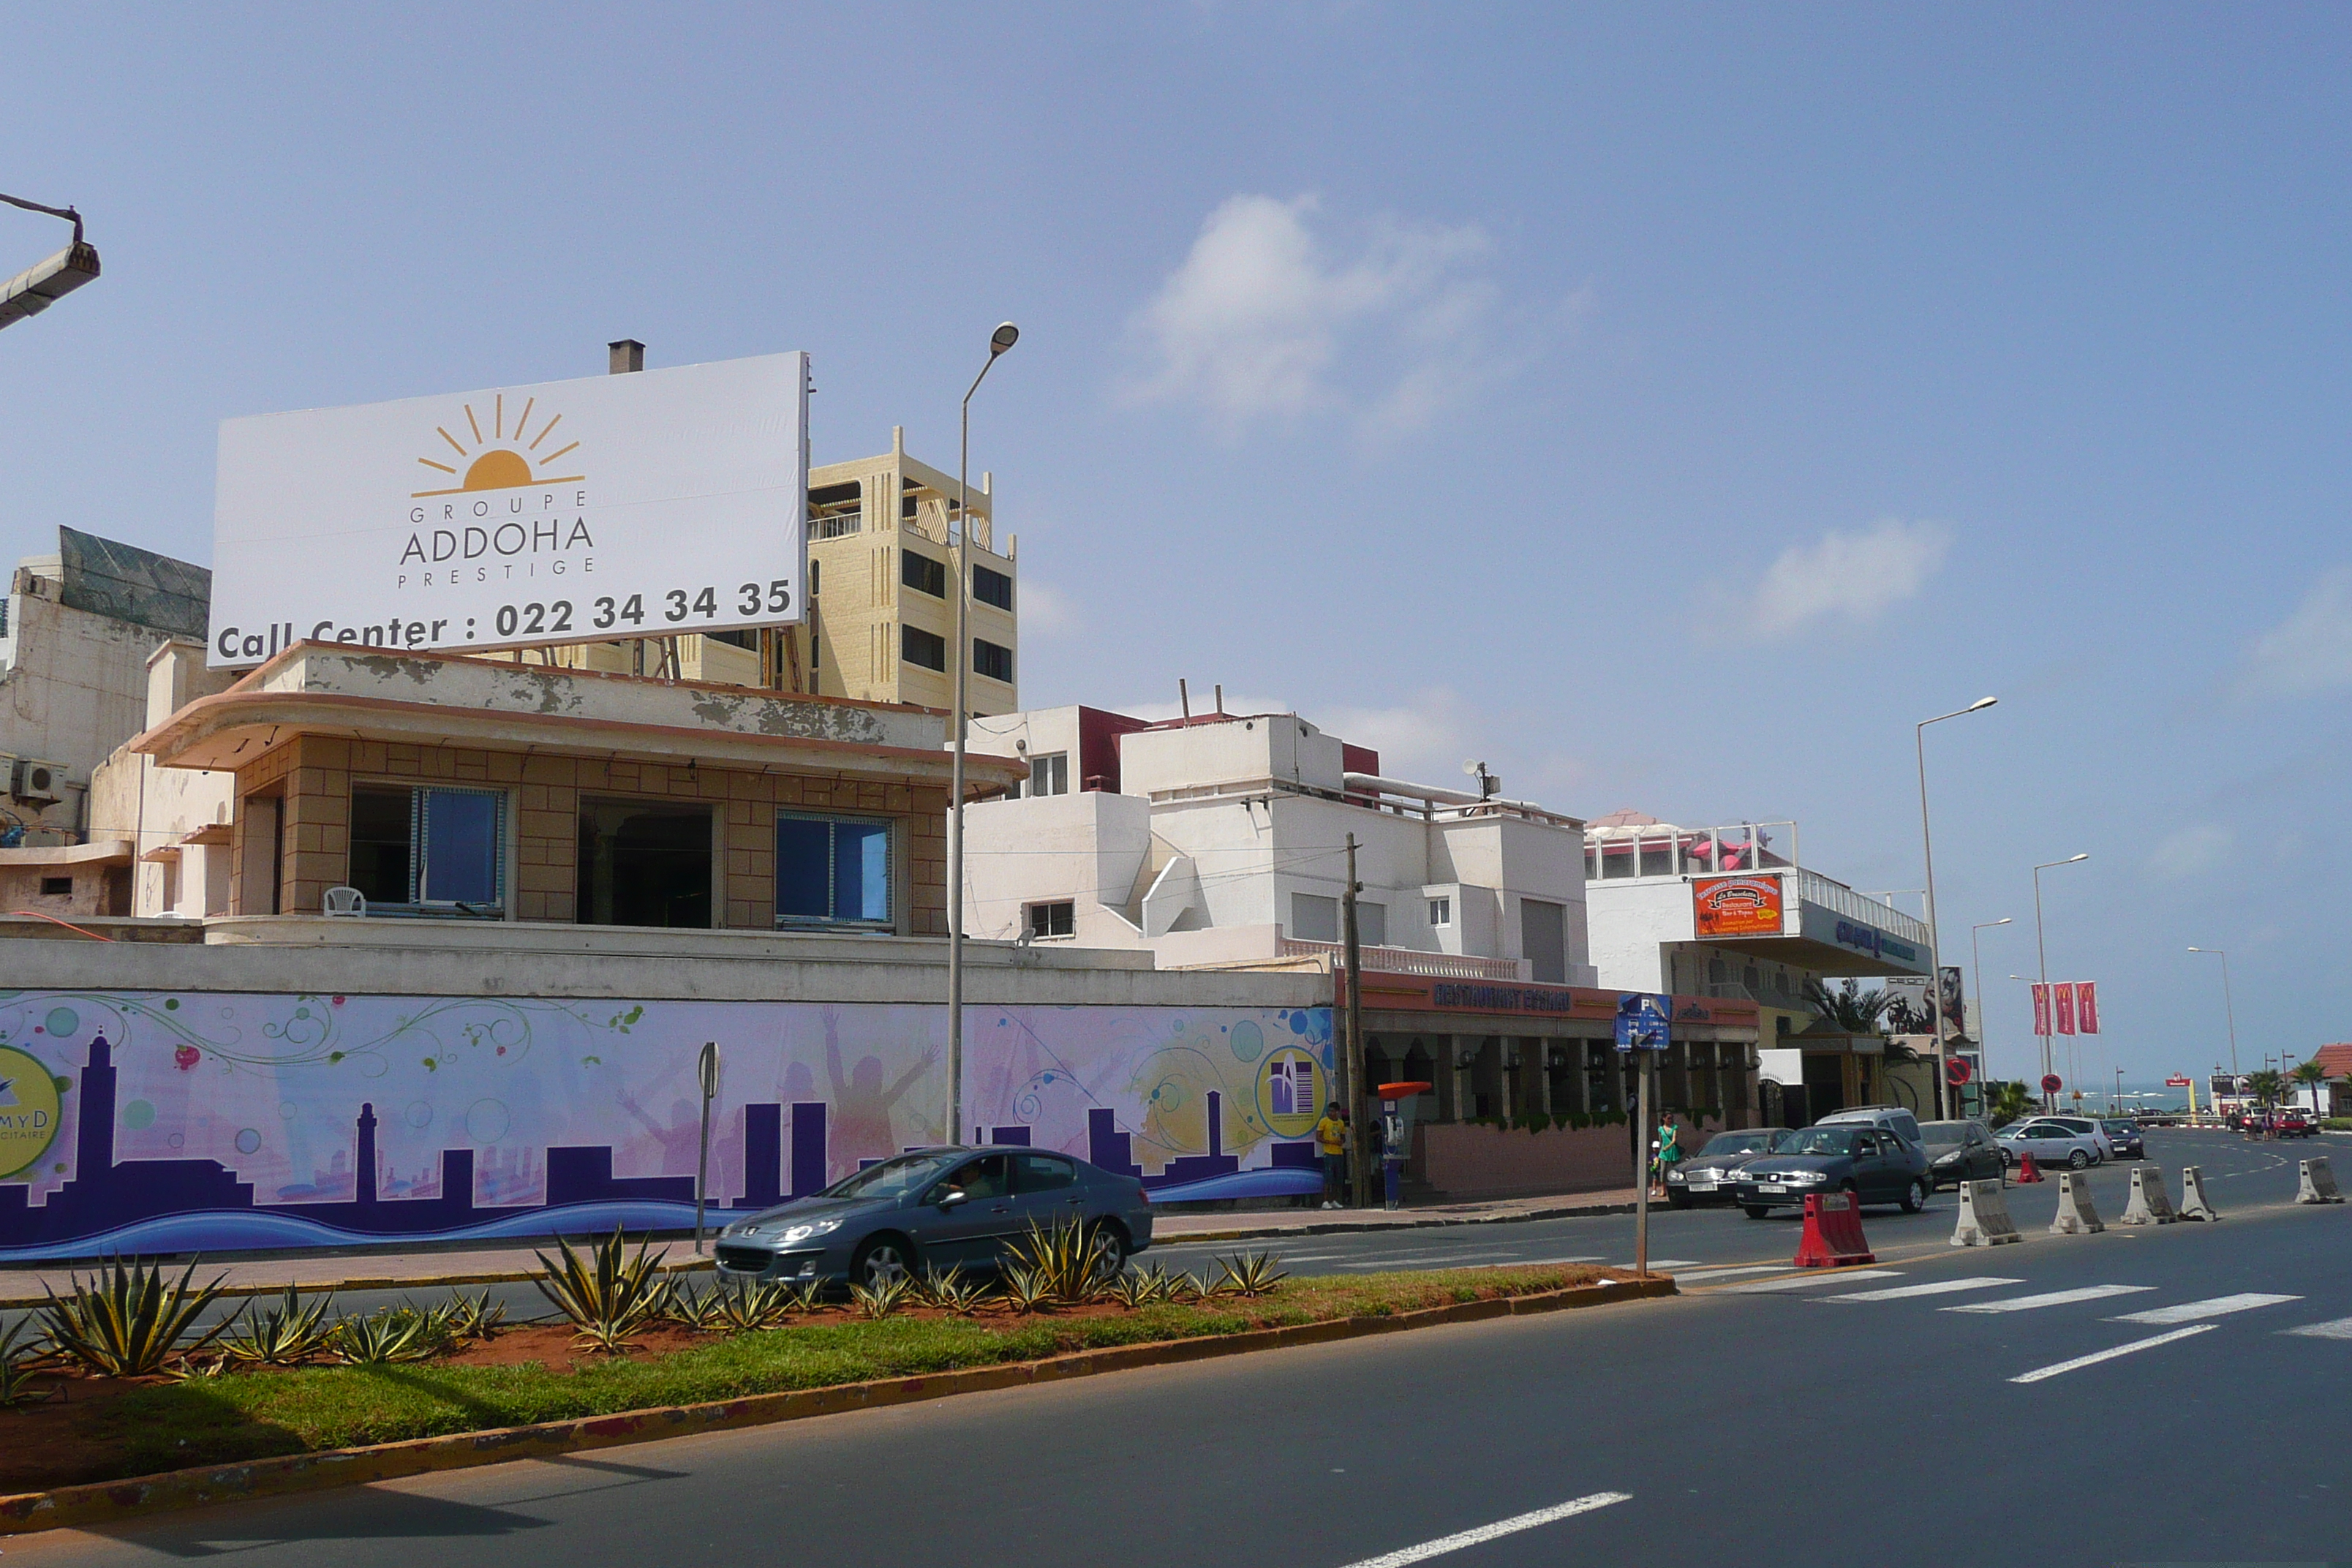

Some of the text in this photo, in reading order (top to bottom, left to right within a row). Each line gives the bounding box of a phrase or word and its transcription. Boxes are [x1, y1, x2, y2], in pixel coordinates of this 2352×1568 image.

[410, 491, 585, 522] GROUPE
[399, 516, 593, 565] ADDOHA
[398, 558, 593, 589] PRESTIGE
[218, 622, 292, 659] Call
[312, 618, 447, 646] Center
[496, 600, 573, 636] 022
[593, 594, 644, 628] 34
[665, 587, 717, 622] 34
[738, 579, 791, 616] 35
[1435, 984, 1521, 1009] RESTAURANT
[1641, 999, 1650, 1011] P
